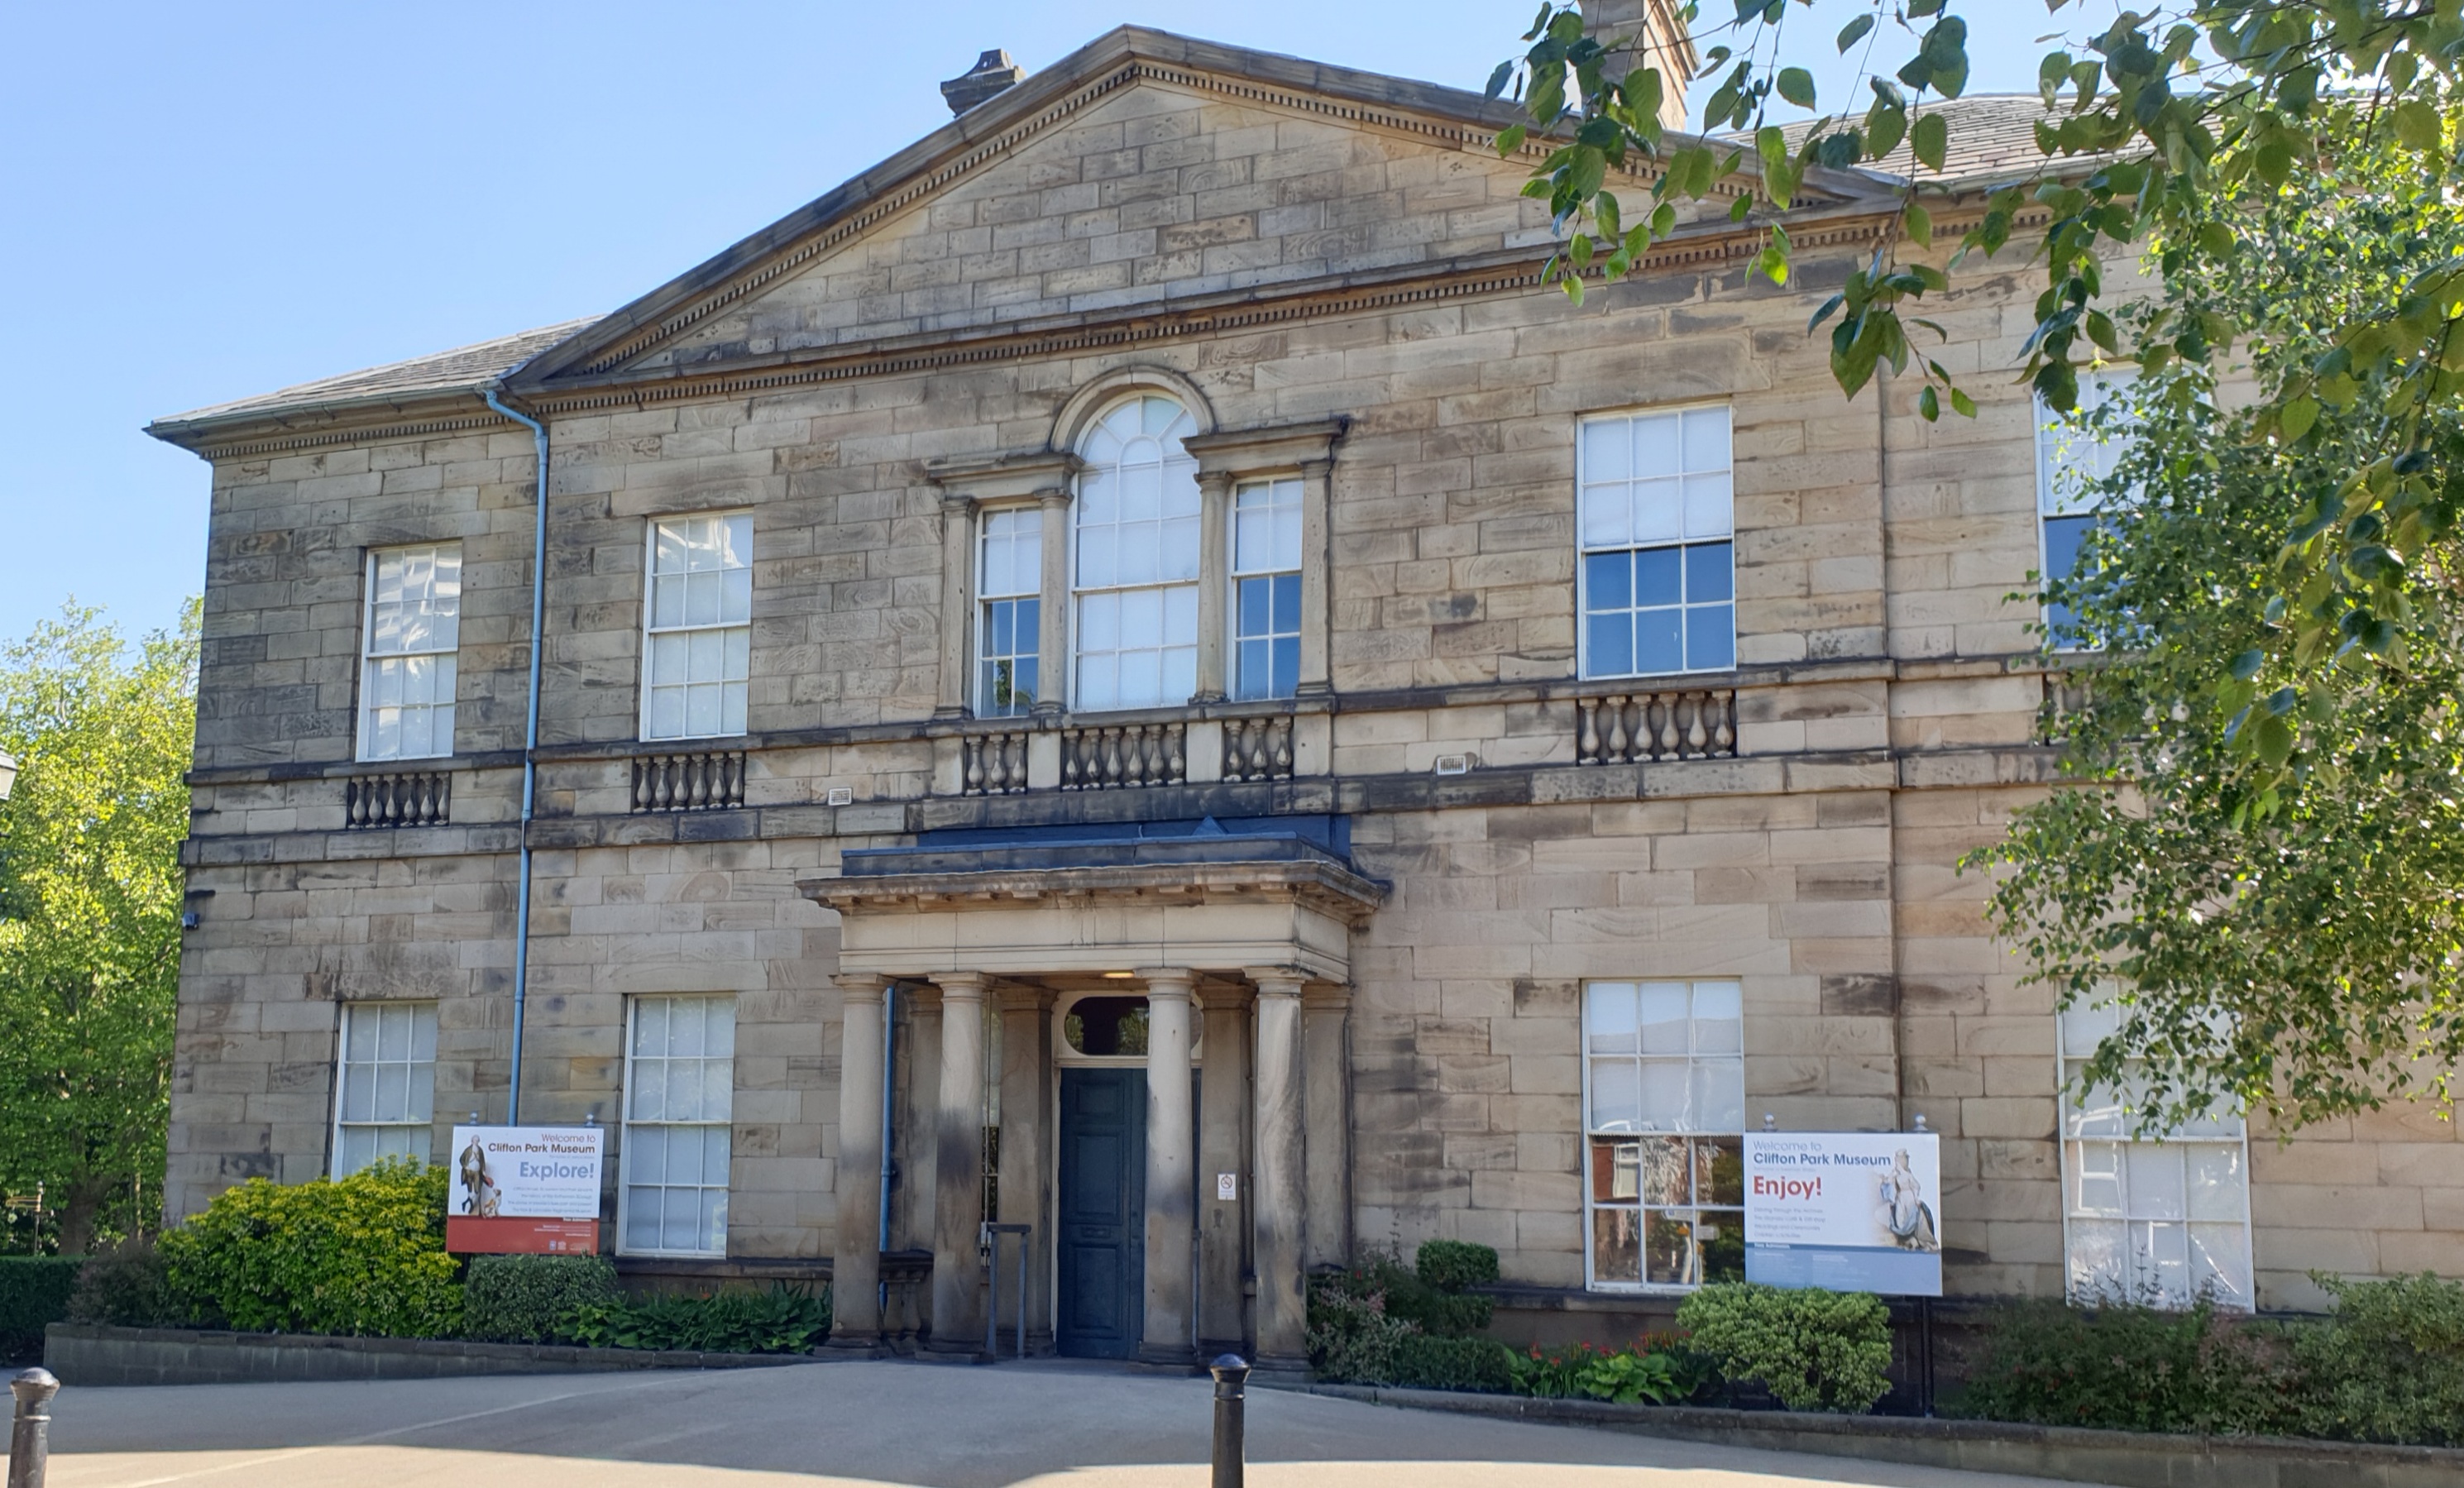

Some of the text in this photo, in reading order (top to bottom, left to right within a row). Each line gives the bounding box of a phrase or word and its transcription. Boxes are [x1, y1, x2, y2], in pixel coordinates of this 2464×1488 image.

[542, 1134, 596, 1143] Welcome to
[488, 1143, 596, 1154] Clifton Park Museum
[1753, 1141, 1822, 1151] Welcome to
[1754, 1152, 1892, 1166] Clifton Park Museum
[519, 1161, 595, 1181] Explore!
[1753, 1175, 1822, 1201] Enjoy!
